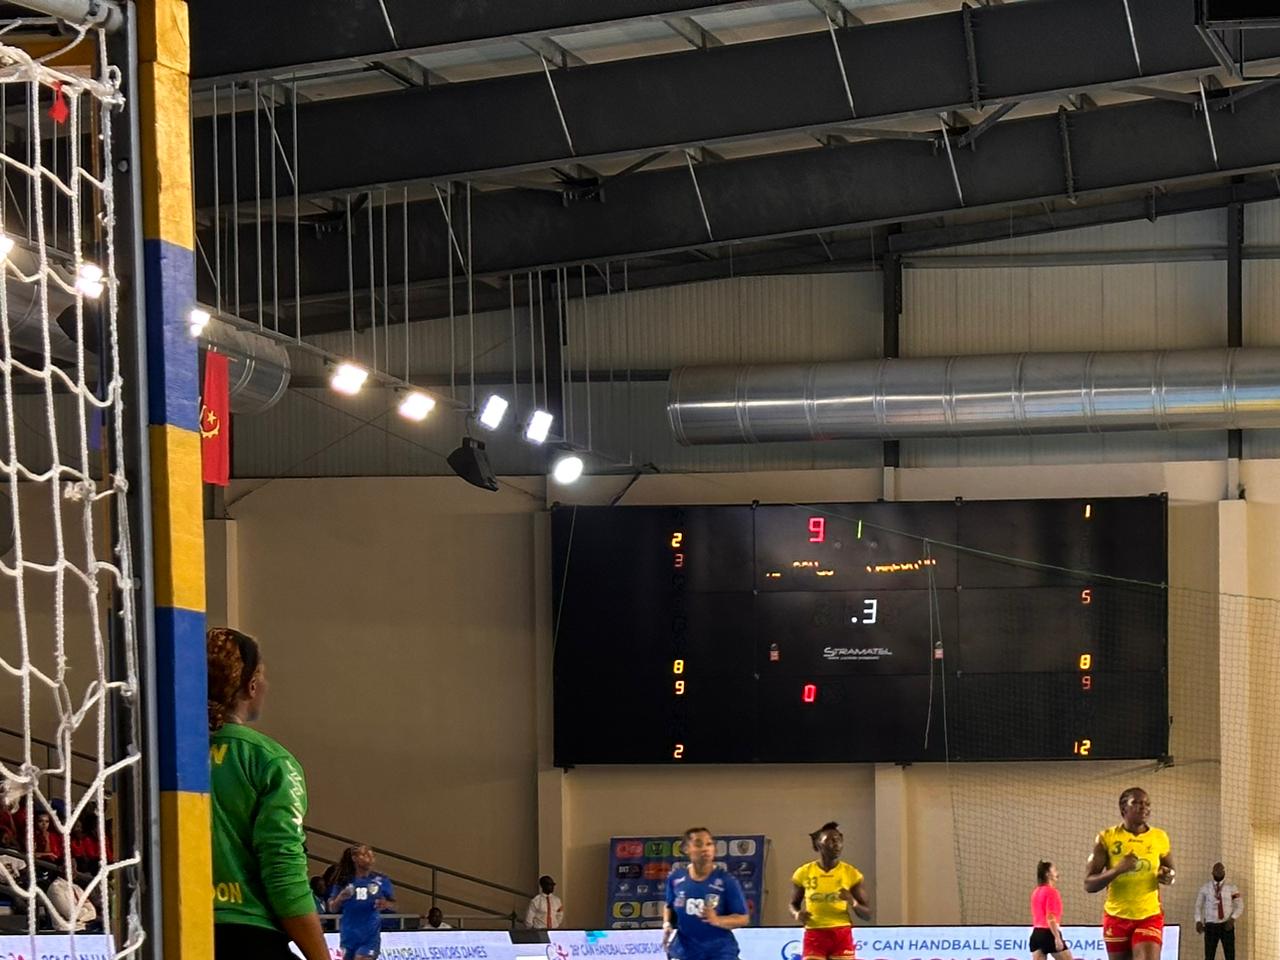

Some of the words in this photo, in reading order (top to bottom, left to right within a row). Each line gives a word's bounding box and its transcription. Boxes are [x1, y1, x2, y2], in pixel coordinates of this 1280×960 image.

[807, 516, 826, 543] 9
[672, 532, 683, 547] 2
[675, 553, 684, 567] 3
[1082, 589, 1091, 603] 5
[823, 647, 893, 657] STRAMATEL
[673, 659, 685, 674] 8
[1080, 654, 1091, 670] 8
[675, 680, 685, 695] 9
[1082, 675, 1091, 690] 9
[803, 684, 817, 702] 0
[673, 744, 684, 759] 2
[1073, 740, 1092, 756] 12
[1111, 841, 1123, 855] 3
[384, 947, 430, 960] HANDBALL
[460, 946, 488, 959] DAMES
[872, 940, 904, 951] CAN
[909, 940, 990, 950] HANDBALL
[994, 940, 1028, 951] SENI
[1065, 940, 1105, 950] DAME
